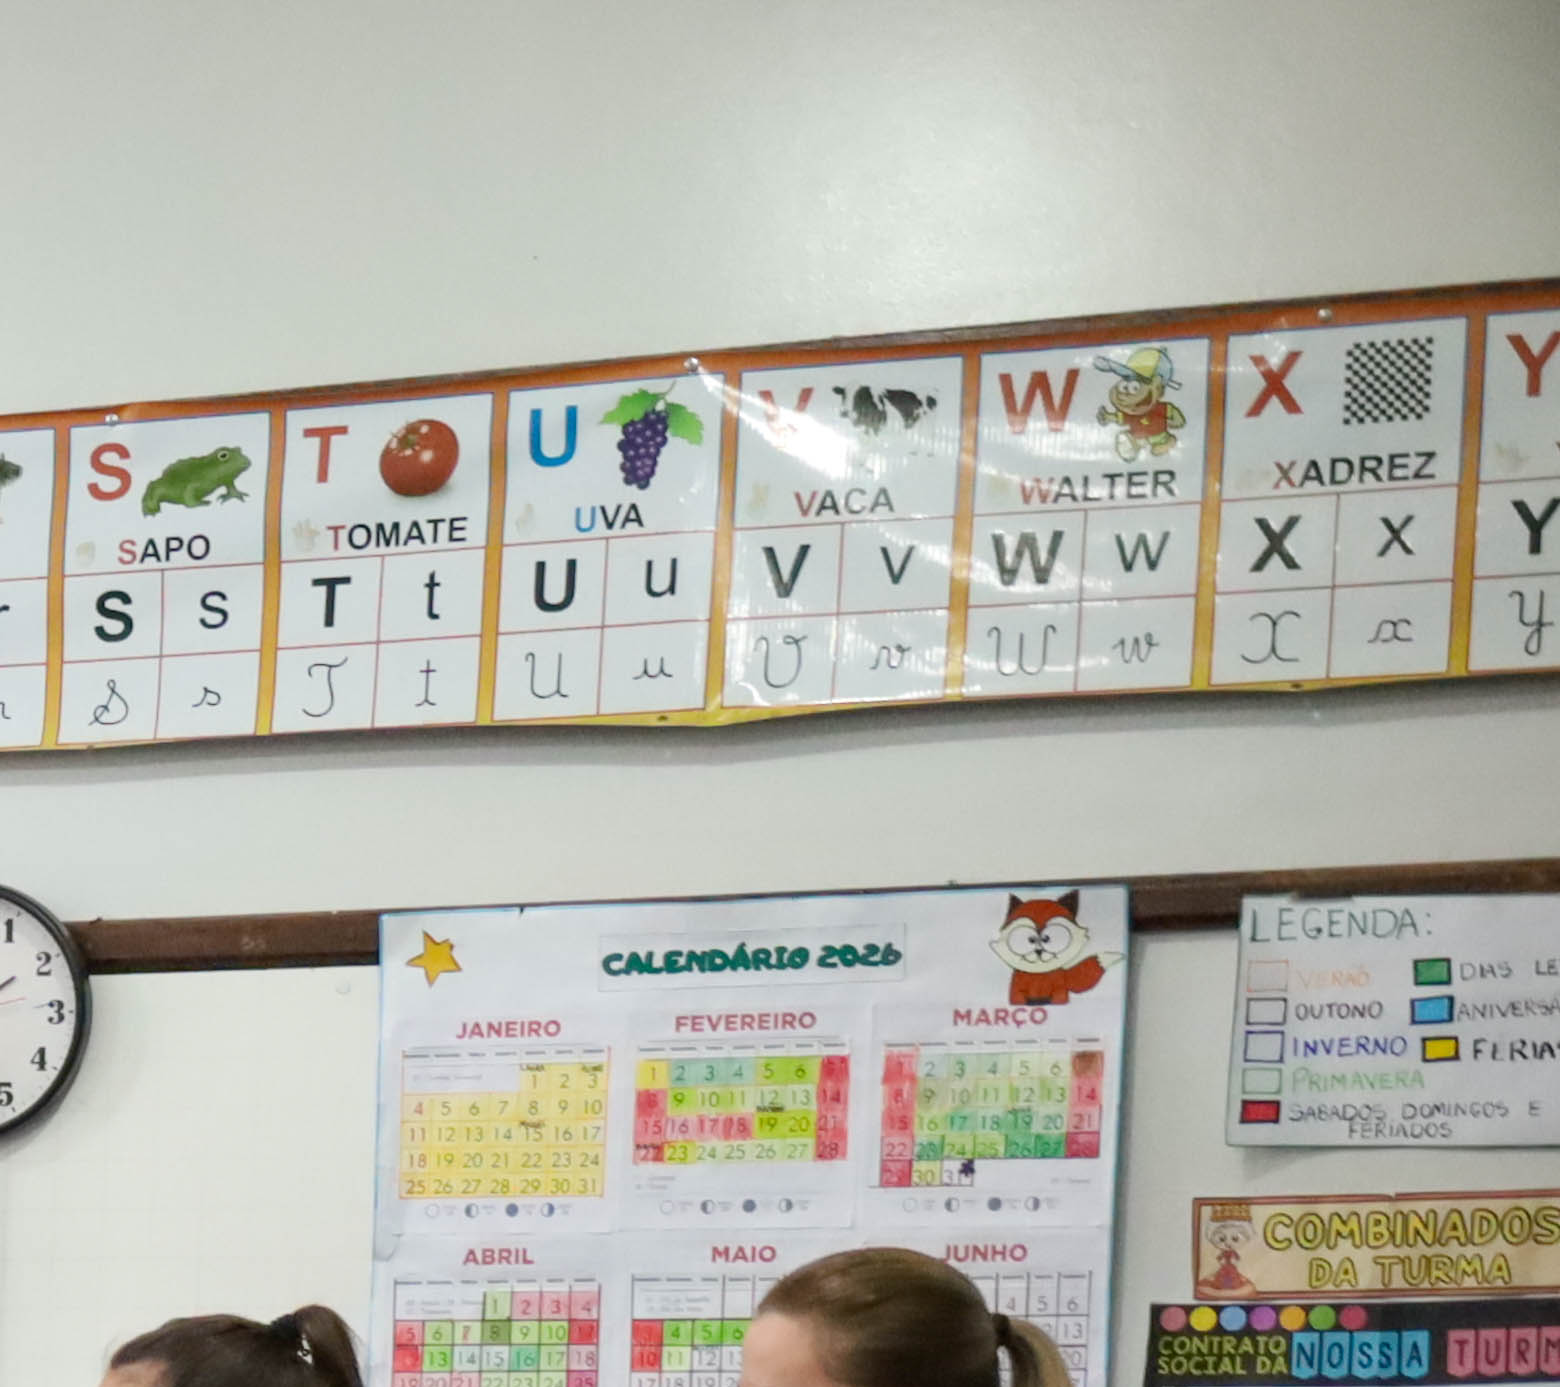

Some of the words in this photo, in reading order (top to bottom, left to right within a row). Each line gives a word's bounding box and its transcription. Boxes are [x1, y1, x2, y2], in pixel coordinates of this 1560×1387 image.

[1274, 451, 1437, 488] XADREZ
[1021, 471, 1176, 506] WALTER
[794, 488, 894, 517] VACA
[575, 504, 644, 532] UVA
[328, 517, 468, 550] TOMATE
[119, 535, 211, 566] SAPO
[4, 918, 14, 943] 1
[1249, 909, 1432, 943] LEGENDA:
[36, 952, 51, 976] 2
[603, 942, 810, 978] CALENDÁRIO
[818, 942, 902, 970] 2026
[48, 1000, 64, 1024] 3
[674, 1010, 817, 1033] FEVEREIRO
[952, 1005, 1049, 1030] MARÇO
[1295, 1002, 1384, 1021] OUTONO
[456, 1017, 562, 1040] JANEIRO
[30, 1047, 47, 1071] 4
[1293, 1035, 1408, 1058] INVERNO
[1291, 1067, 1425, 1093] PRIMAVERA
[1401, 1103, 1510, 1119] DOMINGOS
[1529, 1103, 1541, 1117] E
[1349, 1122, 1453, 1140] FERIADOS
[1264, 1207, 1560, 1249] COMBINADOS
[463, 1248, 534, 1266] ABRIL
[711, 1244, 777, 1263] MAIO
[941, 1243, 1028, 1262] JUNHO
[1308, 1258, 1358, 1288] DA
[1375, 1255, 1511, 1284] TURMA
[1158, 1356, 1246, 1374] SOCIAL
[1257, 1356, 1287, 1374] DA
[1297, 1336, 1423, 1369] NOSSA
[1159, 1335, 1286, 1354] CONTRATO
